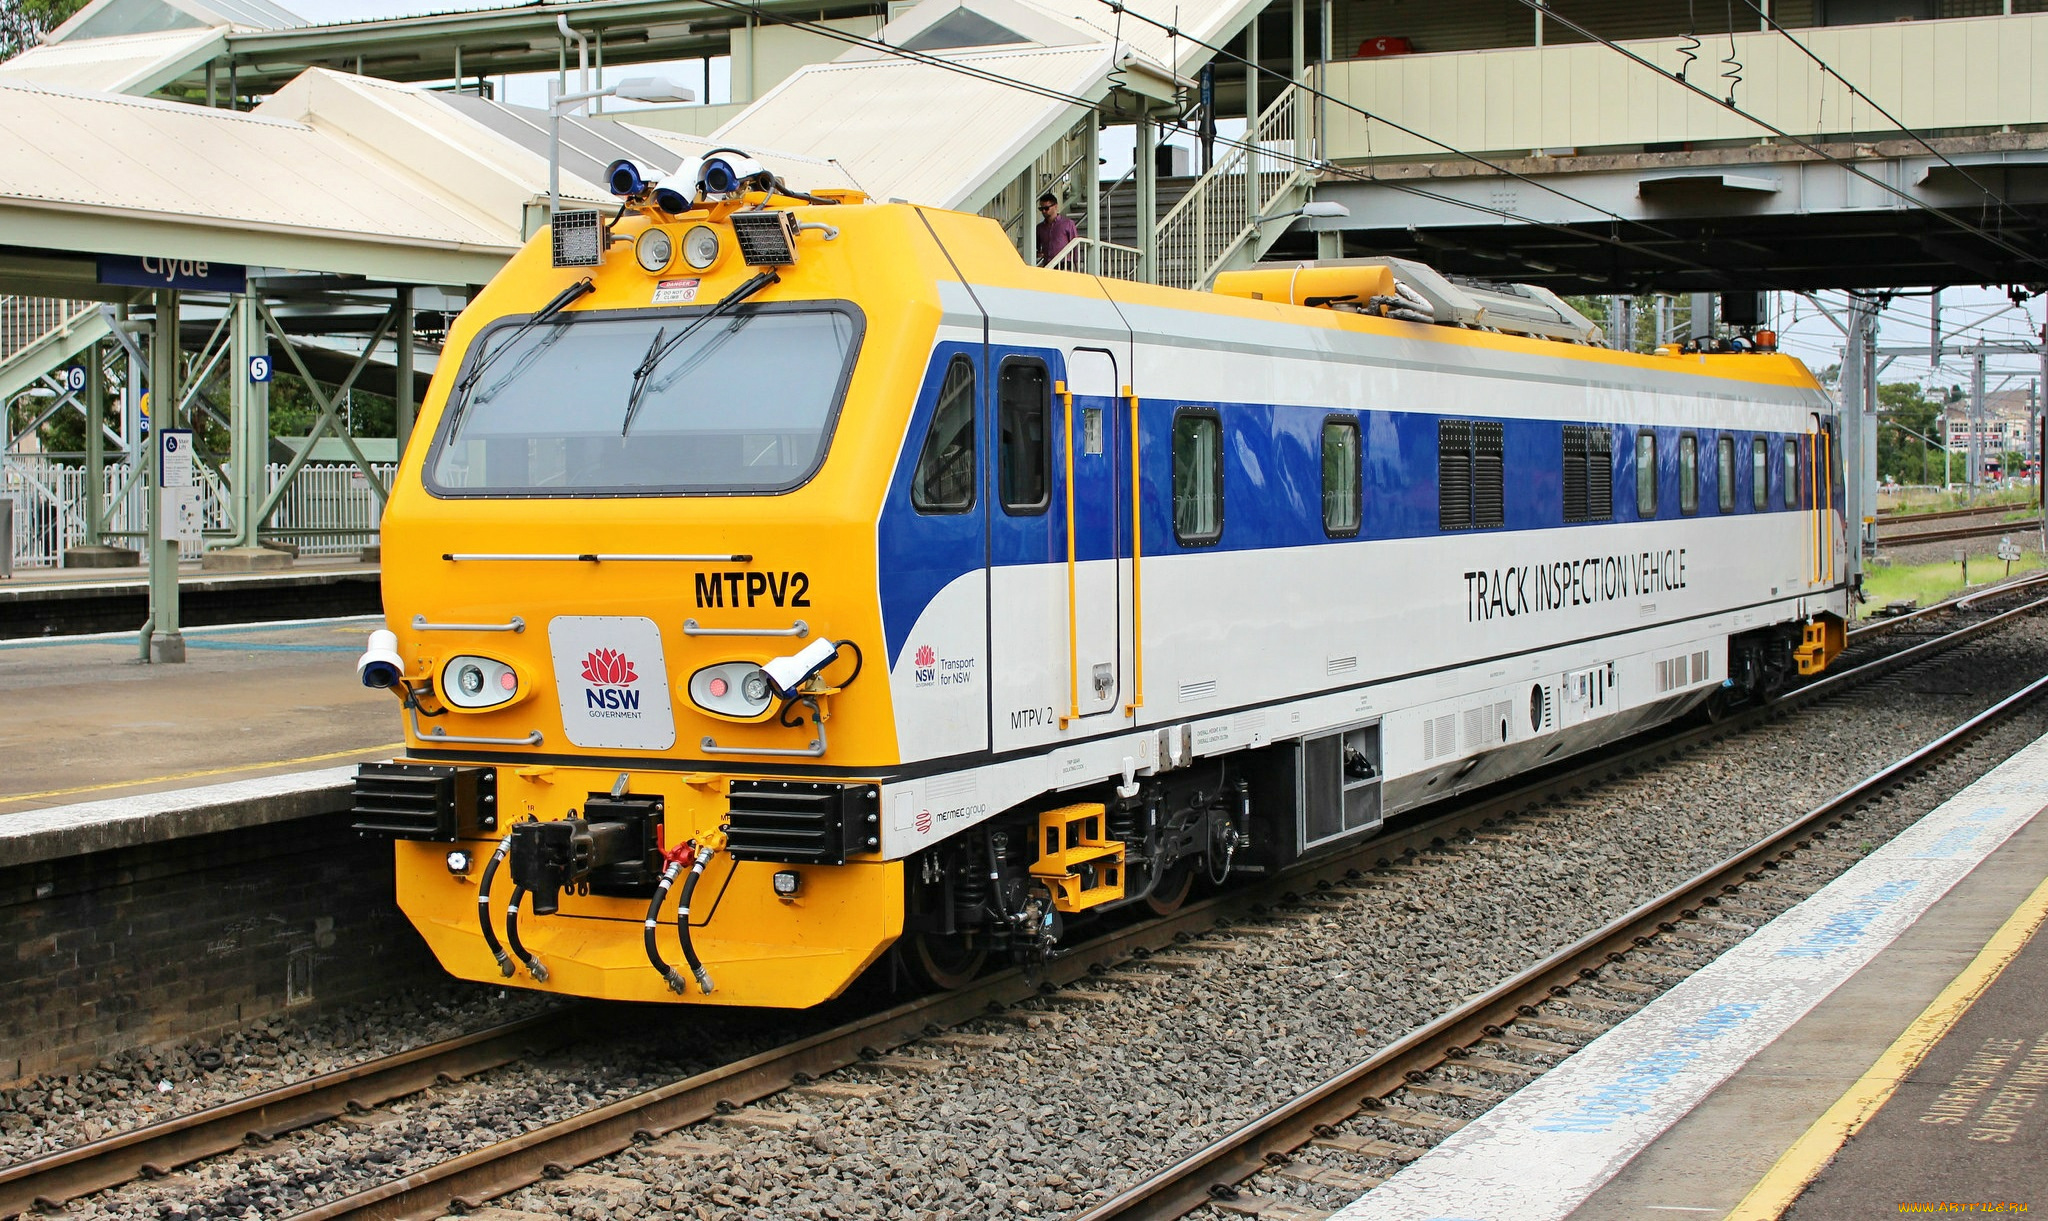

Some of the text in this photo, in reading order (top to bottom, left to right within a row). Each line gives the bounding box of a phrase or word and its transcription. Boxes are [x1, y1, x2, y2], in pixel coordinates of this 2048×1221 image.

[142, 256, 208, 282] Clyde
[73, 371, 81, 386] 6
[256, 361, 263, 377] 5
[694, 571, 811, 608] MTPV2
[1464, 549, 1686, 622] TRACK INSPECTION VEHICLE
[941, 656, 975, 671] Transport
[915, 668, 935, 682] NSW
[940, 671, 971, 685] for NSW
[585, 688, 640, 710] NSW
[588, 710, 642, 719] GOVERNMENT
[1011, 706, 1053, 730] MTPV 2
[965, 803, 986, 819] group
[1919, 1075, 1997, 1125] SURFACE
[1961, 1051, 2012, 1074] MAY
[1967, 1084, 2040, 1143] SLIPPERY
